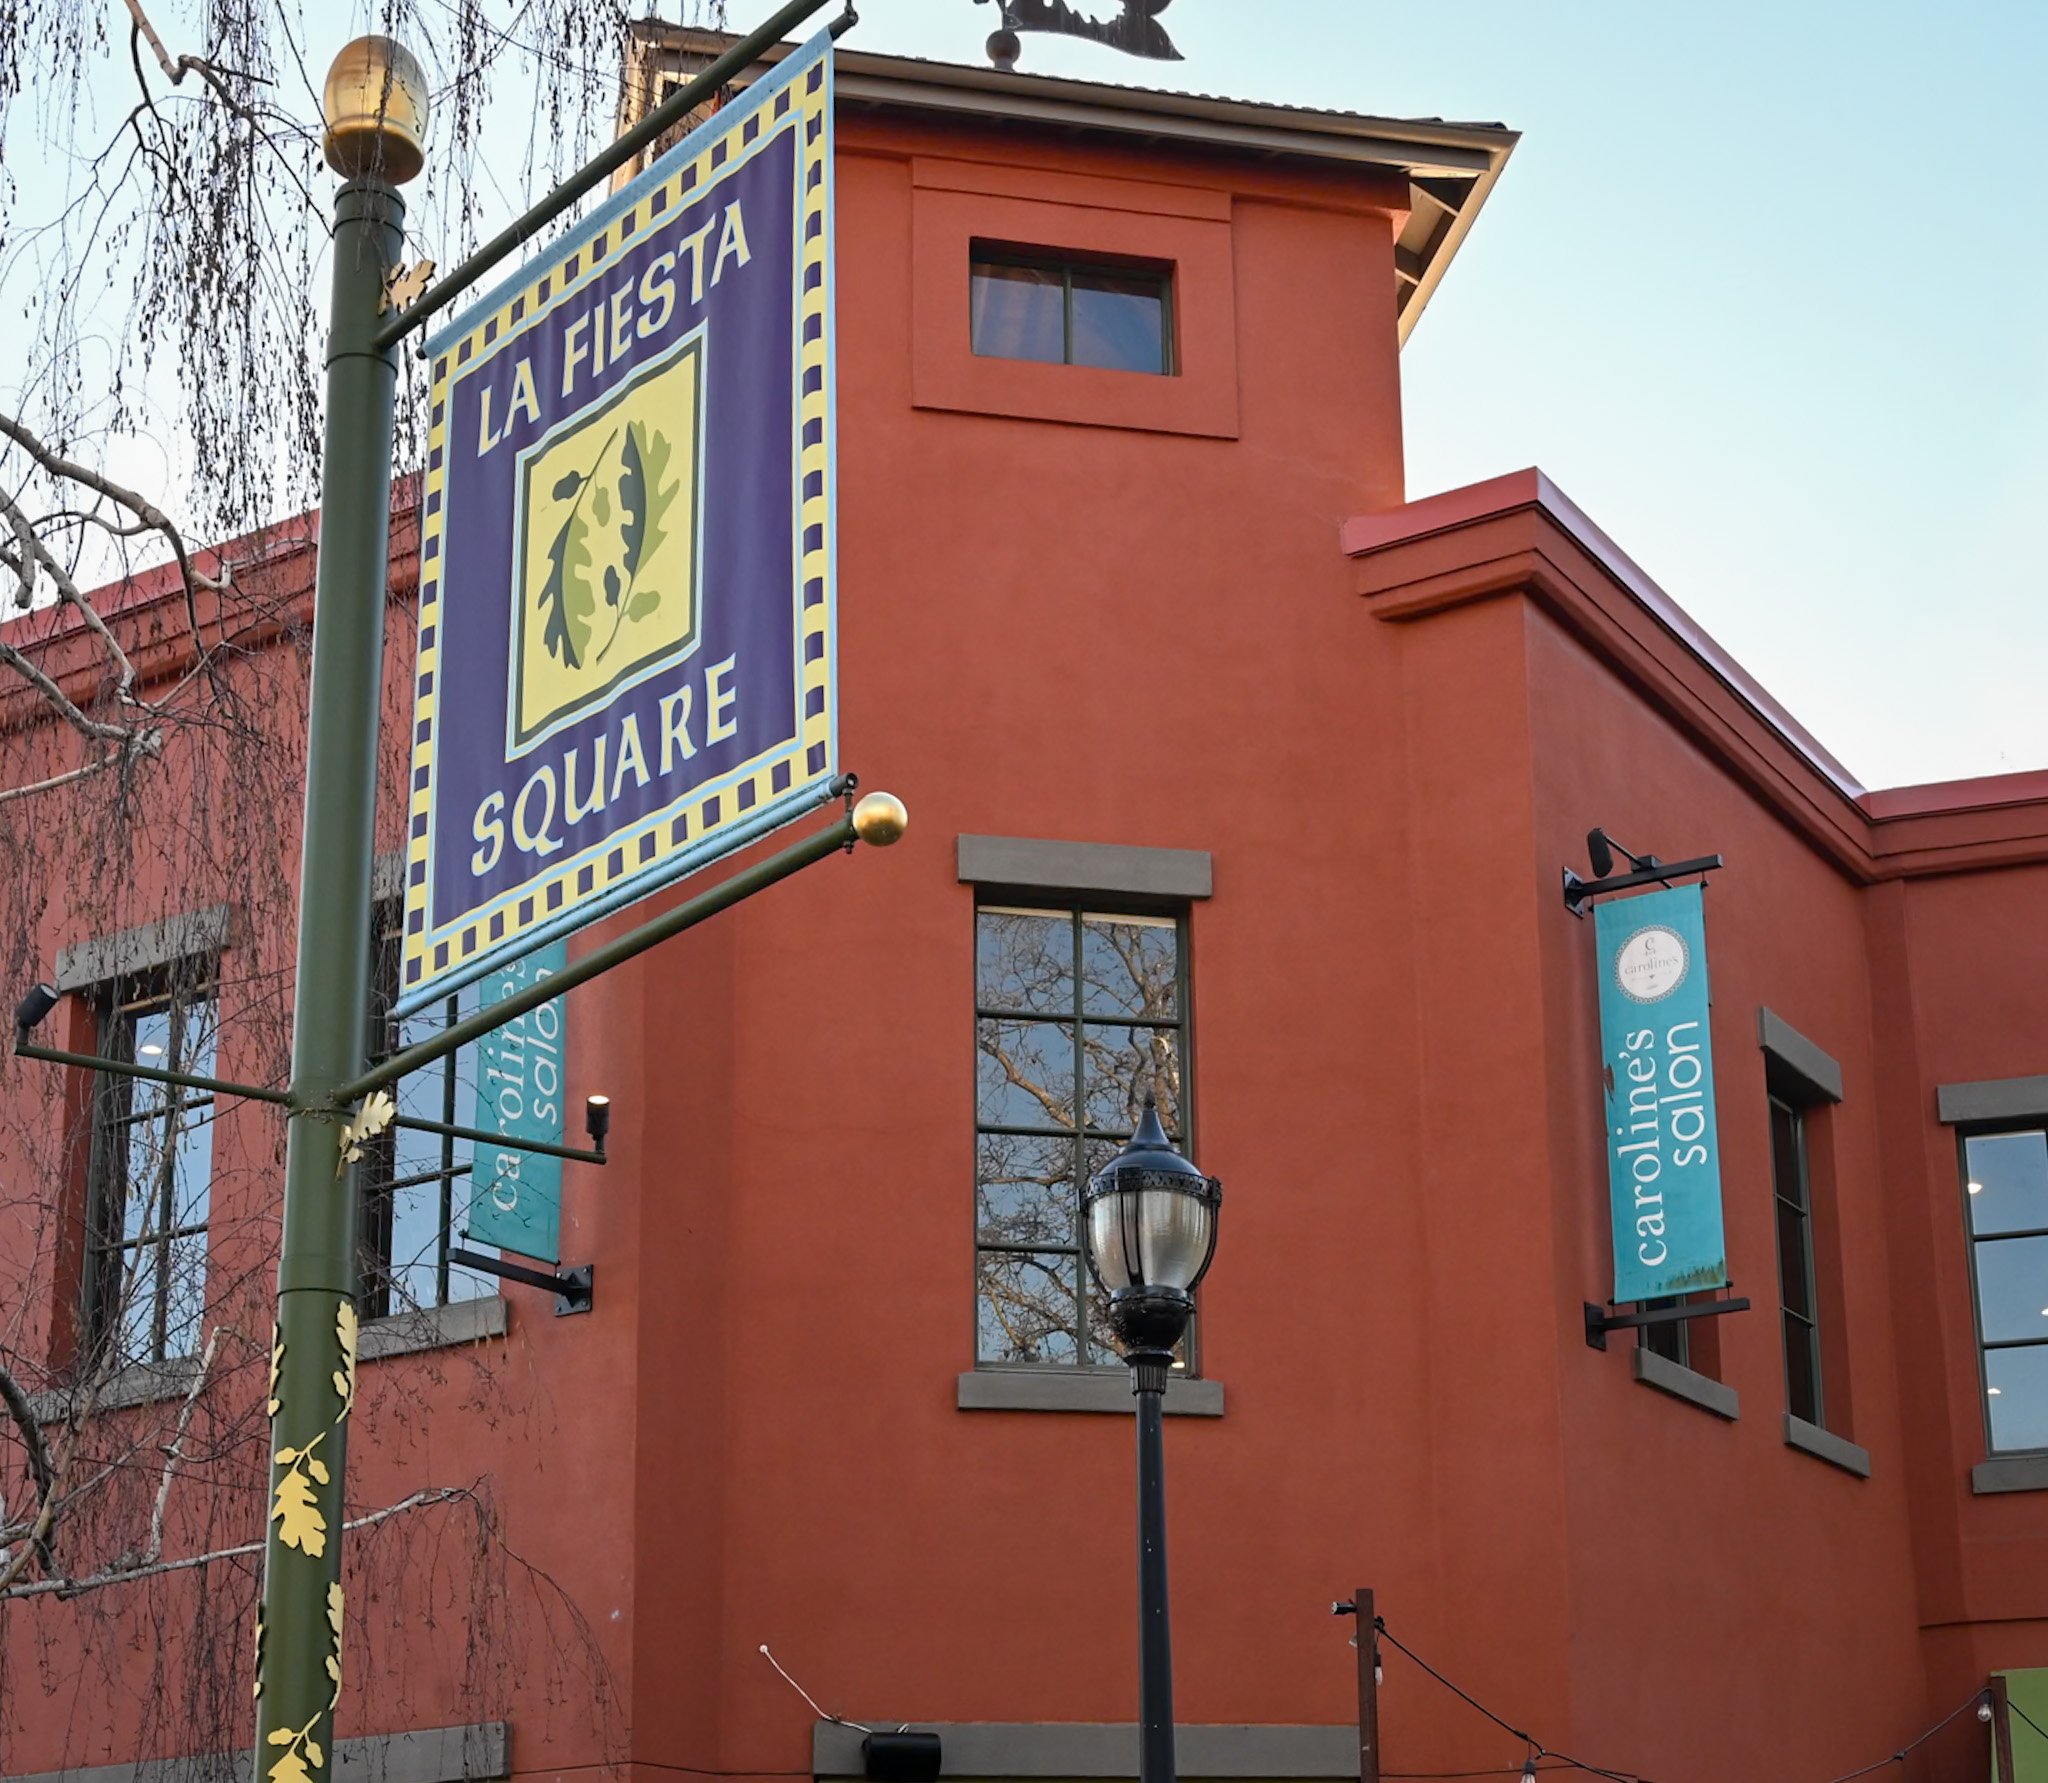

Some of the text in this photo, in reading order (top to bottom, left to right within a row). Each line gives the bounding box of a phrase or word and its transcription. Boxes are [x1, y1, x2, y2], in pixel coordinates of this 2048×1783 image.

[477, 199, 752, 458] LA FIESTA
[470, 652, 738, 877] SQUARE
[1617, 1029, 1668, 1267] caroline's
[1660, 1020, 1707, 1167] salon
